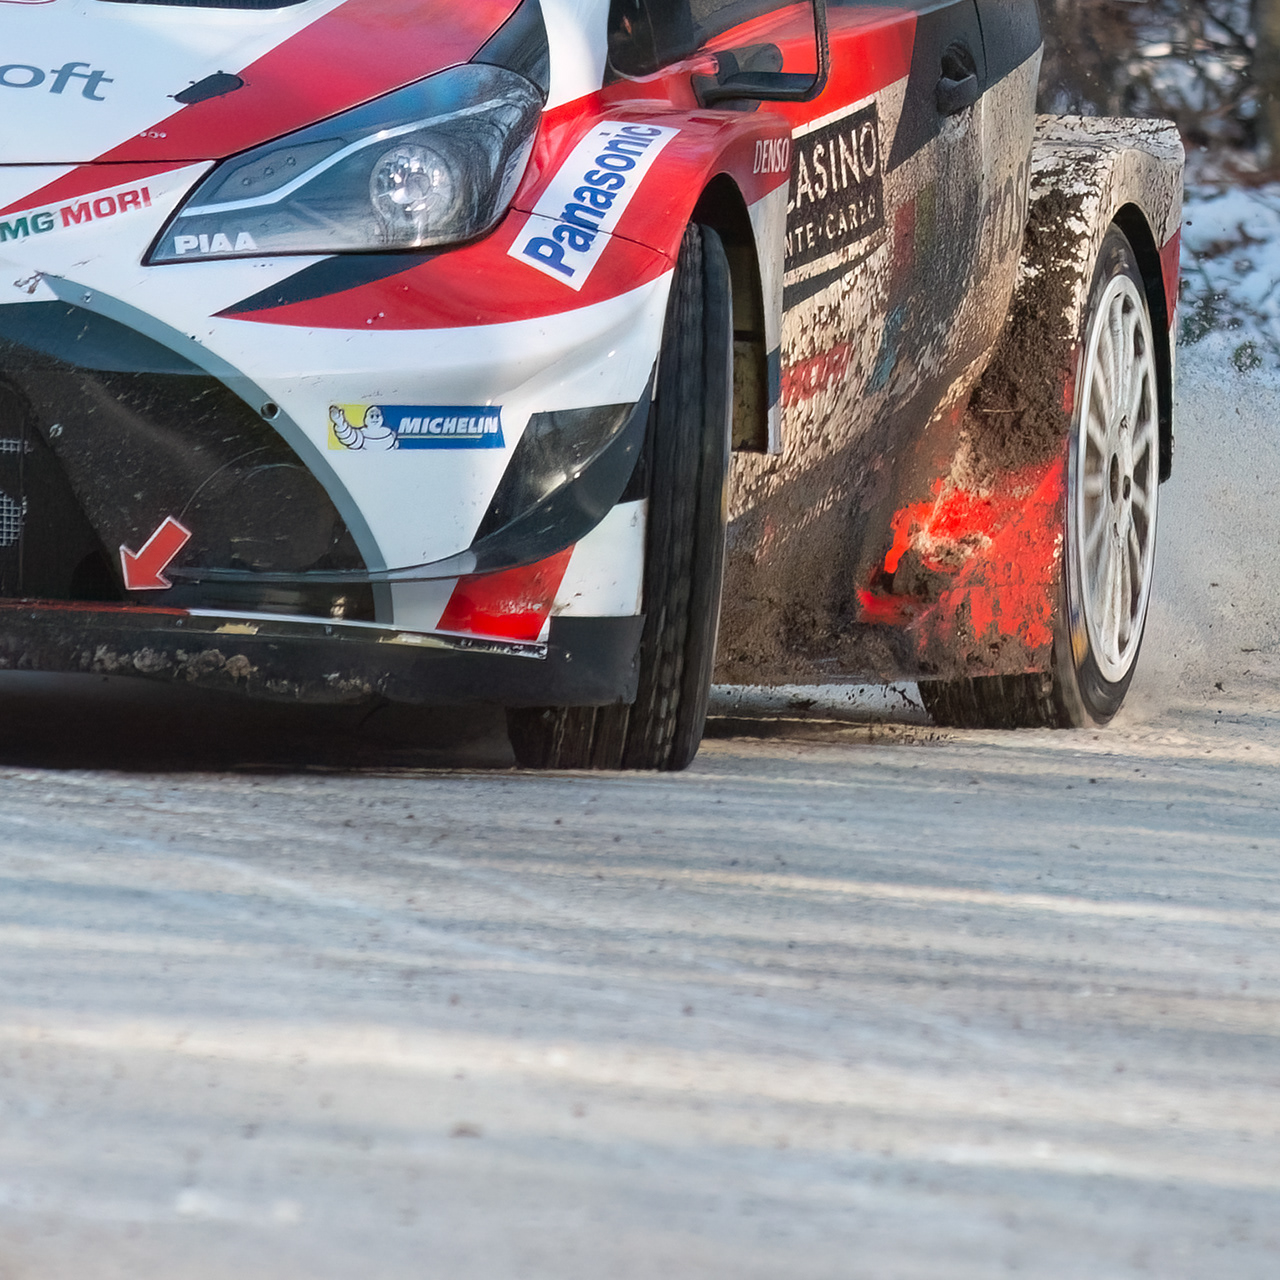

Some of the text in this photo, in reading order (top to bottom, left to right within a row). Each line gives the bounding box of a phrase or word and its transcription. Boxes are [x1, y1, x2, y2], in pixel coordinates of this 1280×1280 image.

[753, 138, 789, 174] DENSO
[787, 122, 877, 214] ASINO
[59, 186, 153, 227] MORI
[523, 124, 664, 277] Panasonic
[174, 232, 257, 254] PIAA
[398, 417, 498, 434] MICHELIN
